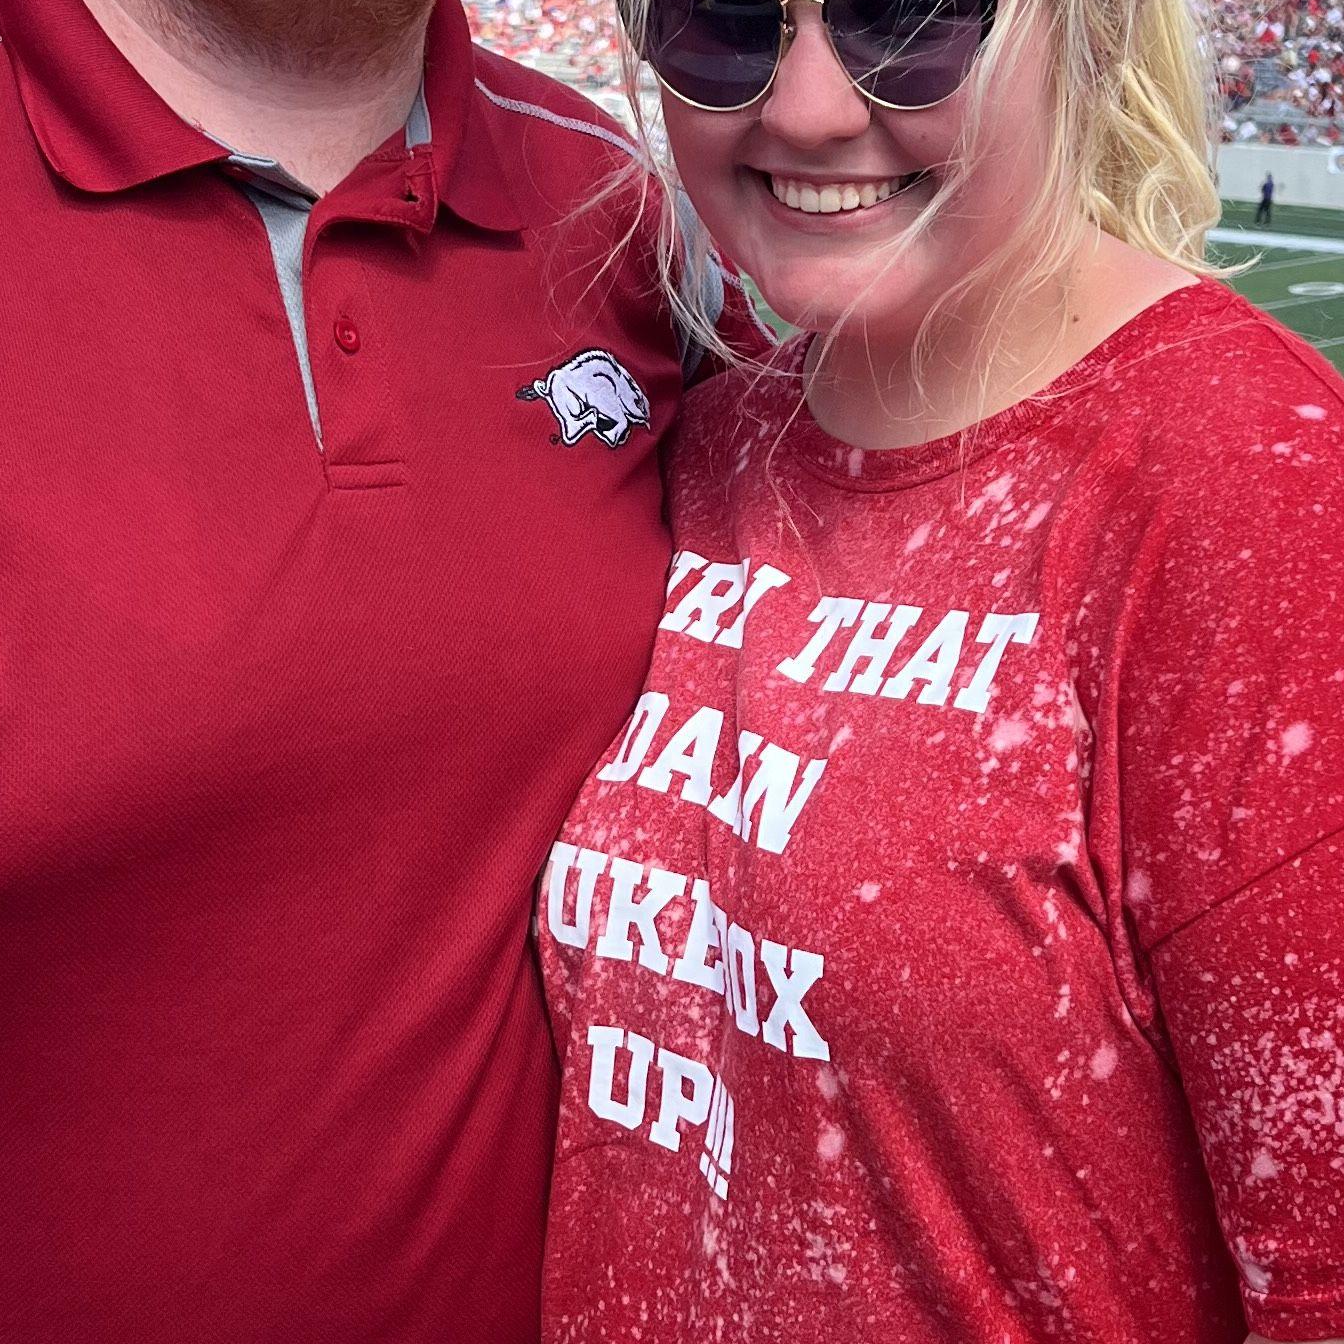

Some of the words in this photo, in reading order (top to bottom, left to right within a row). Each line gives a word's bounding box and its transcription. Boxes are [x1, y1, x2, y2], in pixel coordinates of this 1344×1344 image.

[776, 597, 1040, 714] THAT
[548, 841, 830, 1062] UKEOX
[587, 1026, 735, 1201] UP!!!
